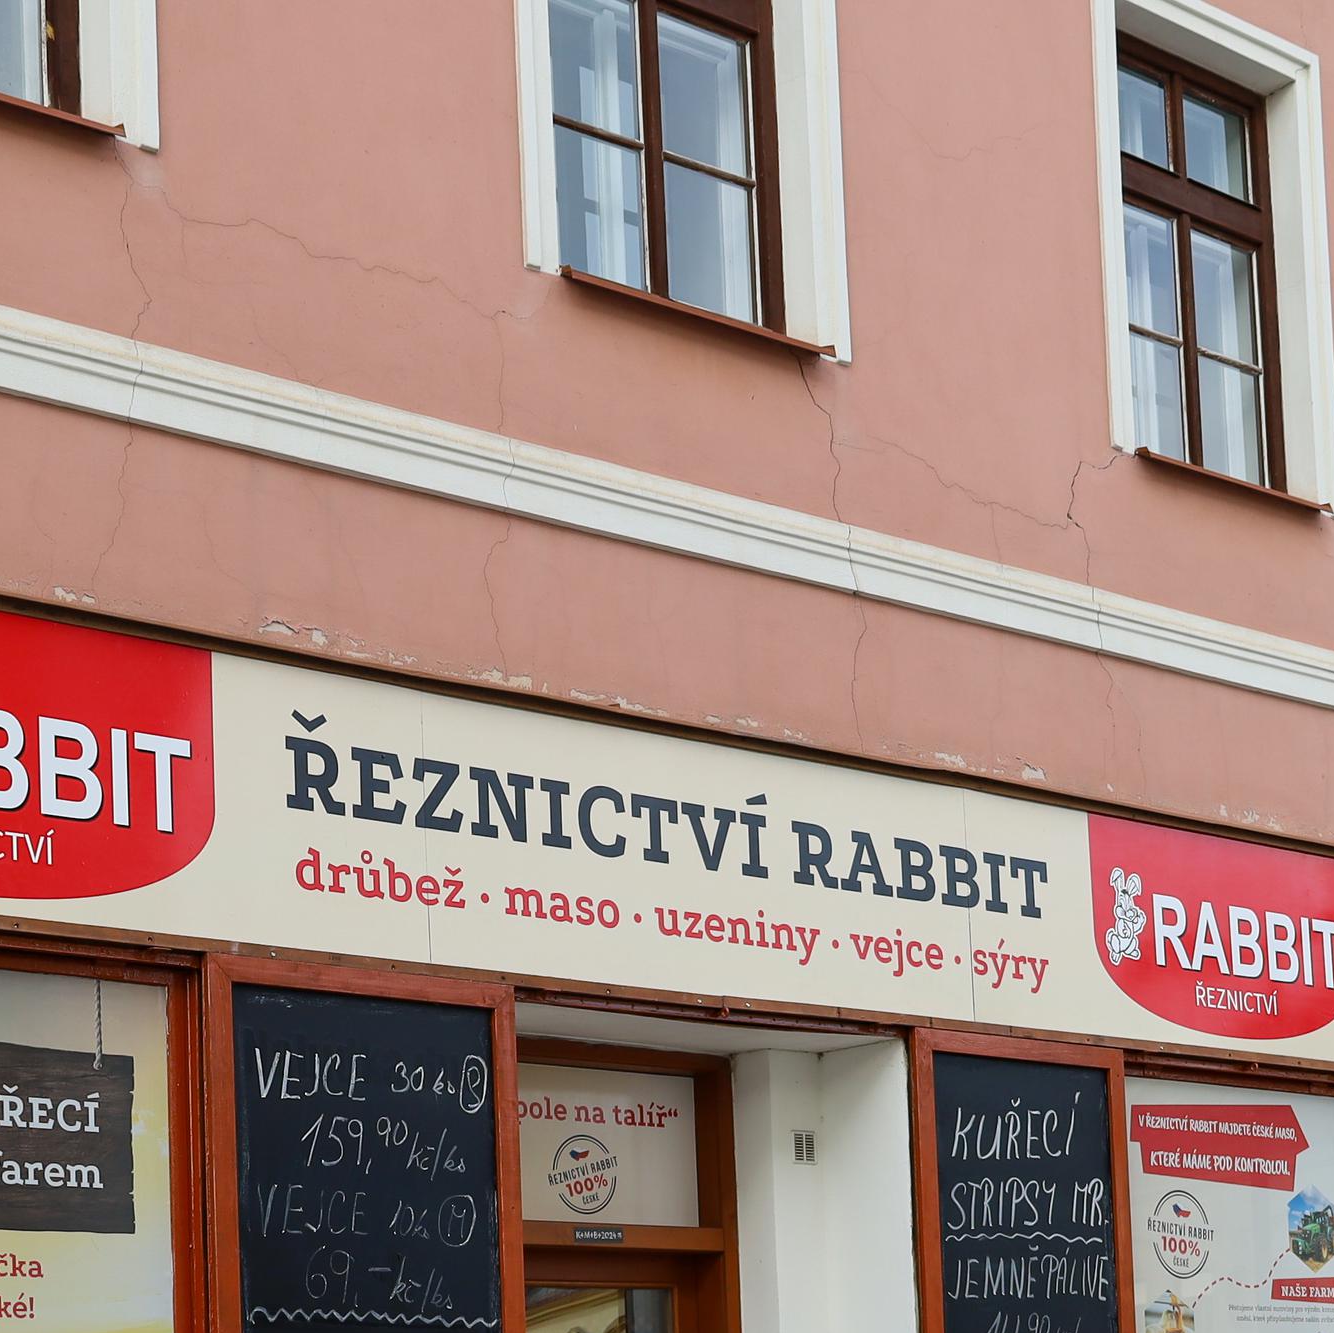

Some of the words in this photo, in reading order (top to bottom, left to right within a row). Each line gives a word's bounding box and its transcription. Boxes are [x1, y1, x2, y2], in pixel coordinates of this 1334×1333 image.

[284, 709, 768, 881] ŘEZNICTVÍ
[792, 820, 1049, 920] RABBIT
[295, 846, 466, 910] drůbež
[503, 885, 620, 930] maso
[654, 906, 821, 966] uzeniny
[851, 930, 944, 977] vejce
[971, 938, 1050, 996] sýry
[1195, 979, 1281, 1017] ŘEZNICTVÍ
[254, 1047, 366, 1101] VEJCE
[574, 1104, 606, 1124] na
[951, 1091, 1081, 1160] KUŘECÍ
[1138, 1115, 1145, 1127] V
[1145, 1113, 1189, 1133] ŘEZNICTVÍ
[1189, 1120, 1218, 1134] RABBIT
[1218, 1122, 1252, 1136] NAJDETE
[1252, 1122, 1274, 1139] ČESKÉ
[1275, 1127, 1298, 1143] MASO,
[548, 1162, 589, 1186] ŘEZNICTVÍ
[590, 1155, 618, 1173] RABBIT
[1150, 1148, 1182, 1168] KTERÉ
[1182, 1150, 1212, 1170] MÁME
[1213, 1154, 1233, 1172] POD
[1234, 1156, 1291, 1177] KONTROLOU.
[565, 1173, 608, 1197] 100%
[257, 1183, 368, 1238] VEJCE
[947, 1177, 1056, 1231] STRIPSY
[1147, 1216, 1187, 1237] ŘEZNICTVÍ
[1188, 1225, 1215, 1242] RABBIT
[1161, 1235, 1201, 1258] 100%
[1281, 1283, 1308, 1298] NAŠE
